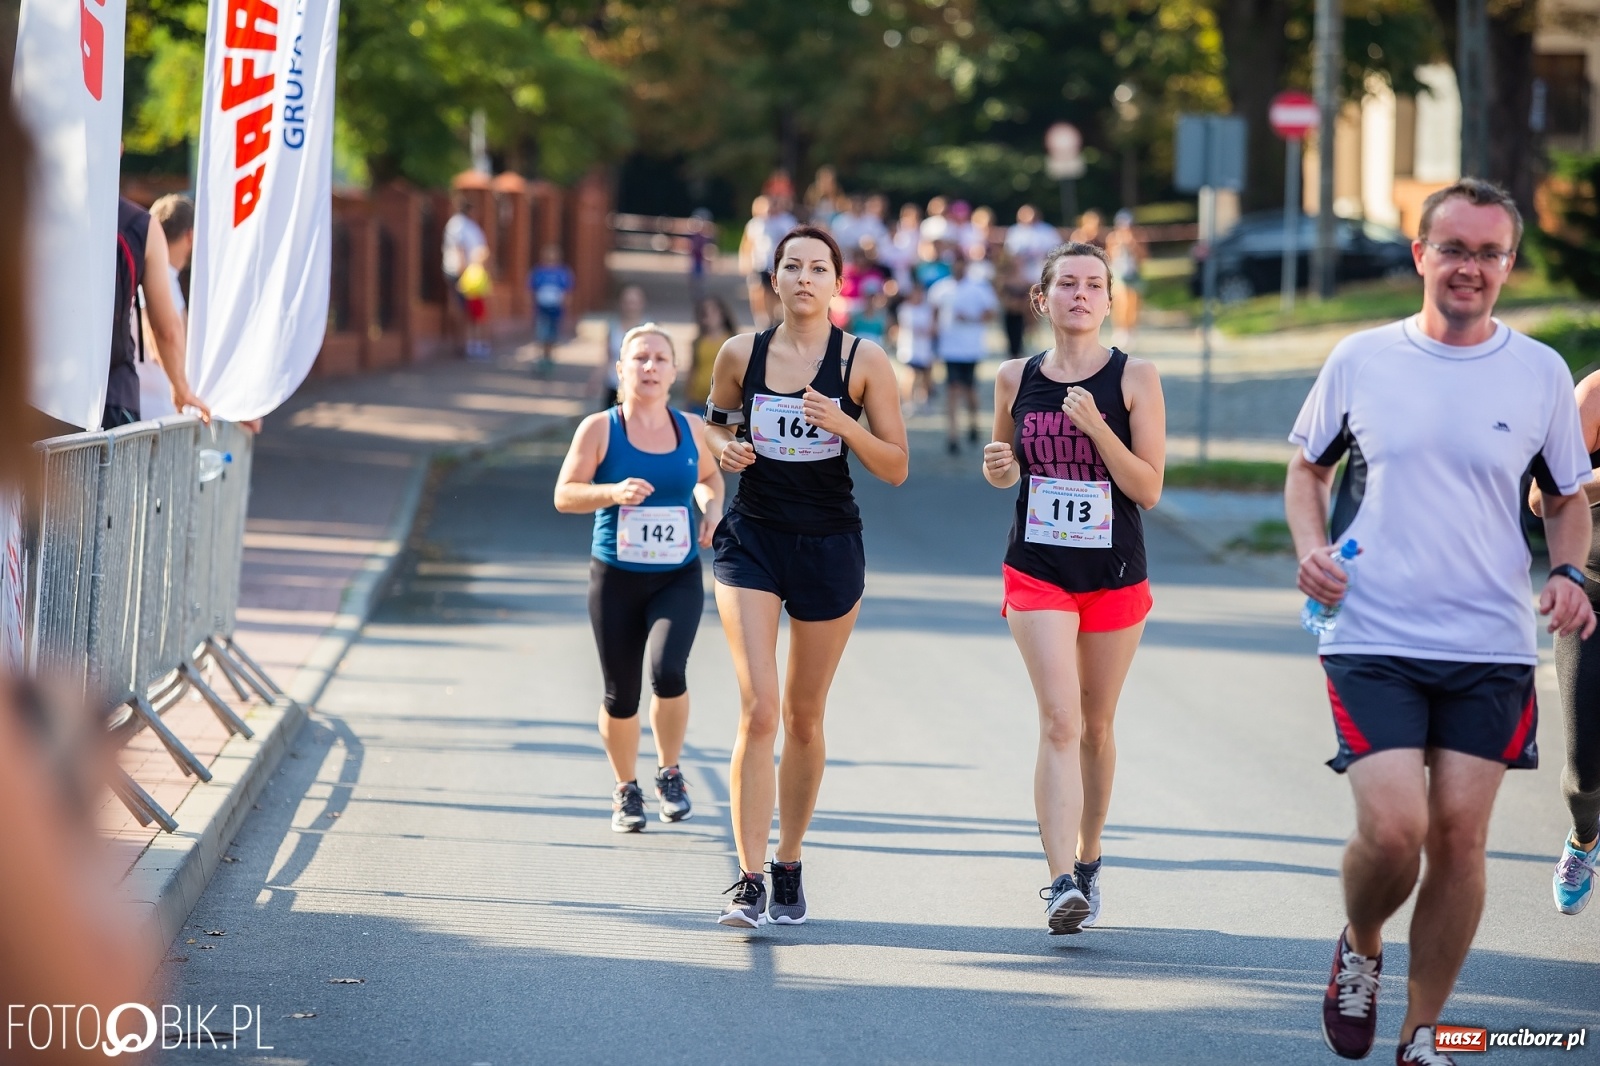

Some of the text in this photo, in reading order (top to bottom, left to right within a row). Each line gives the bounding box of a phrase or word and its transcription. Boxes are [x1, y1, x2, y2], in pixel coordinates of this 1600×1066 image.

[777, 416, 819, 439] 162
[1022, 411, 1107, 437] SWE
[1051, 498, 1092, 523] 113
[641, 524, 675, 543] 142
